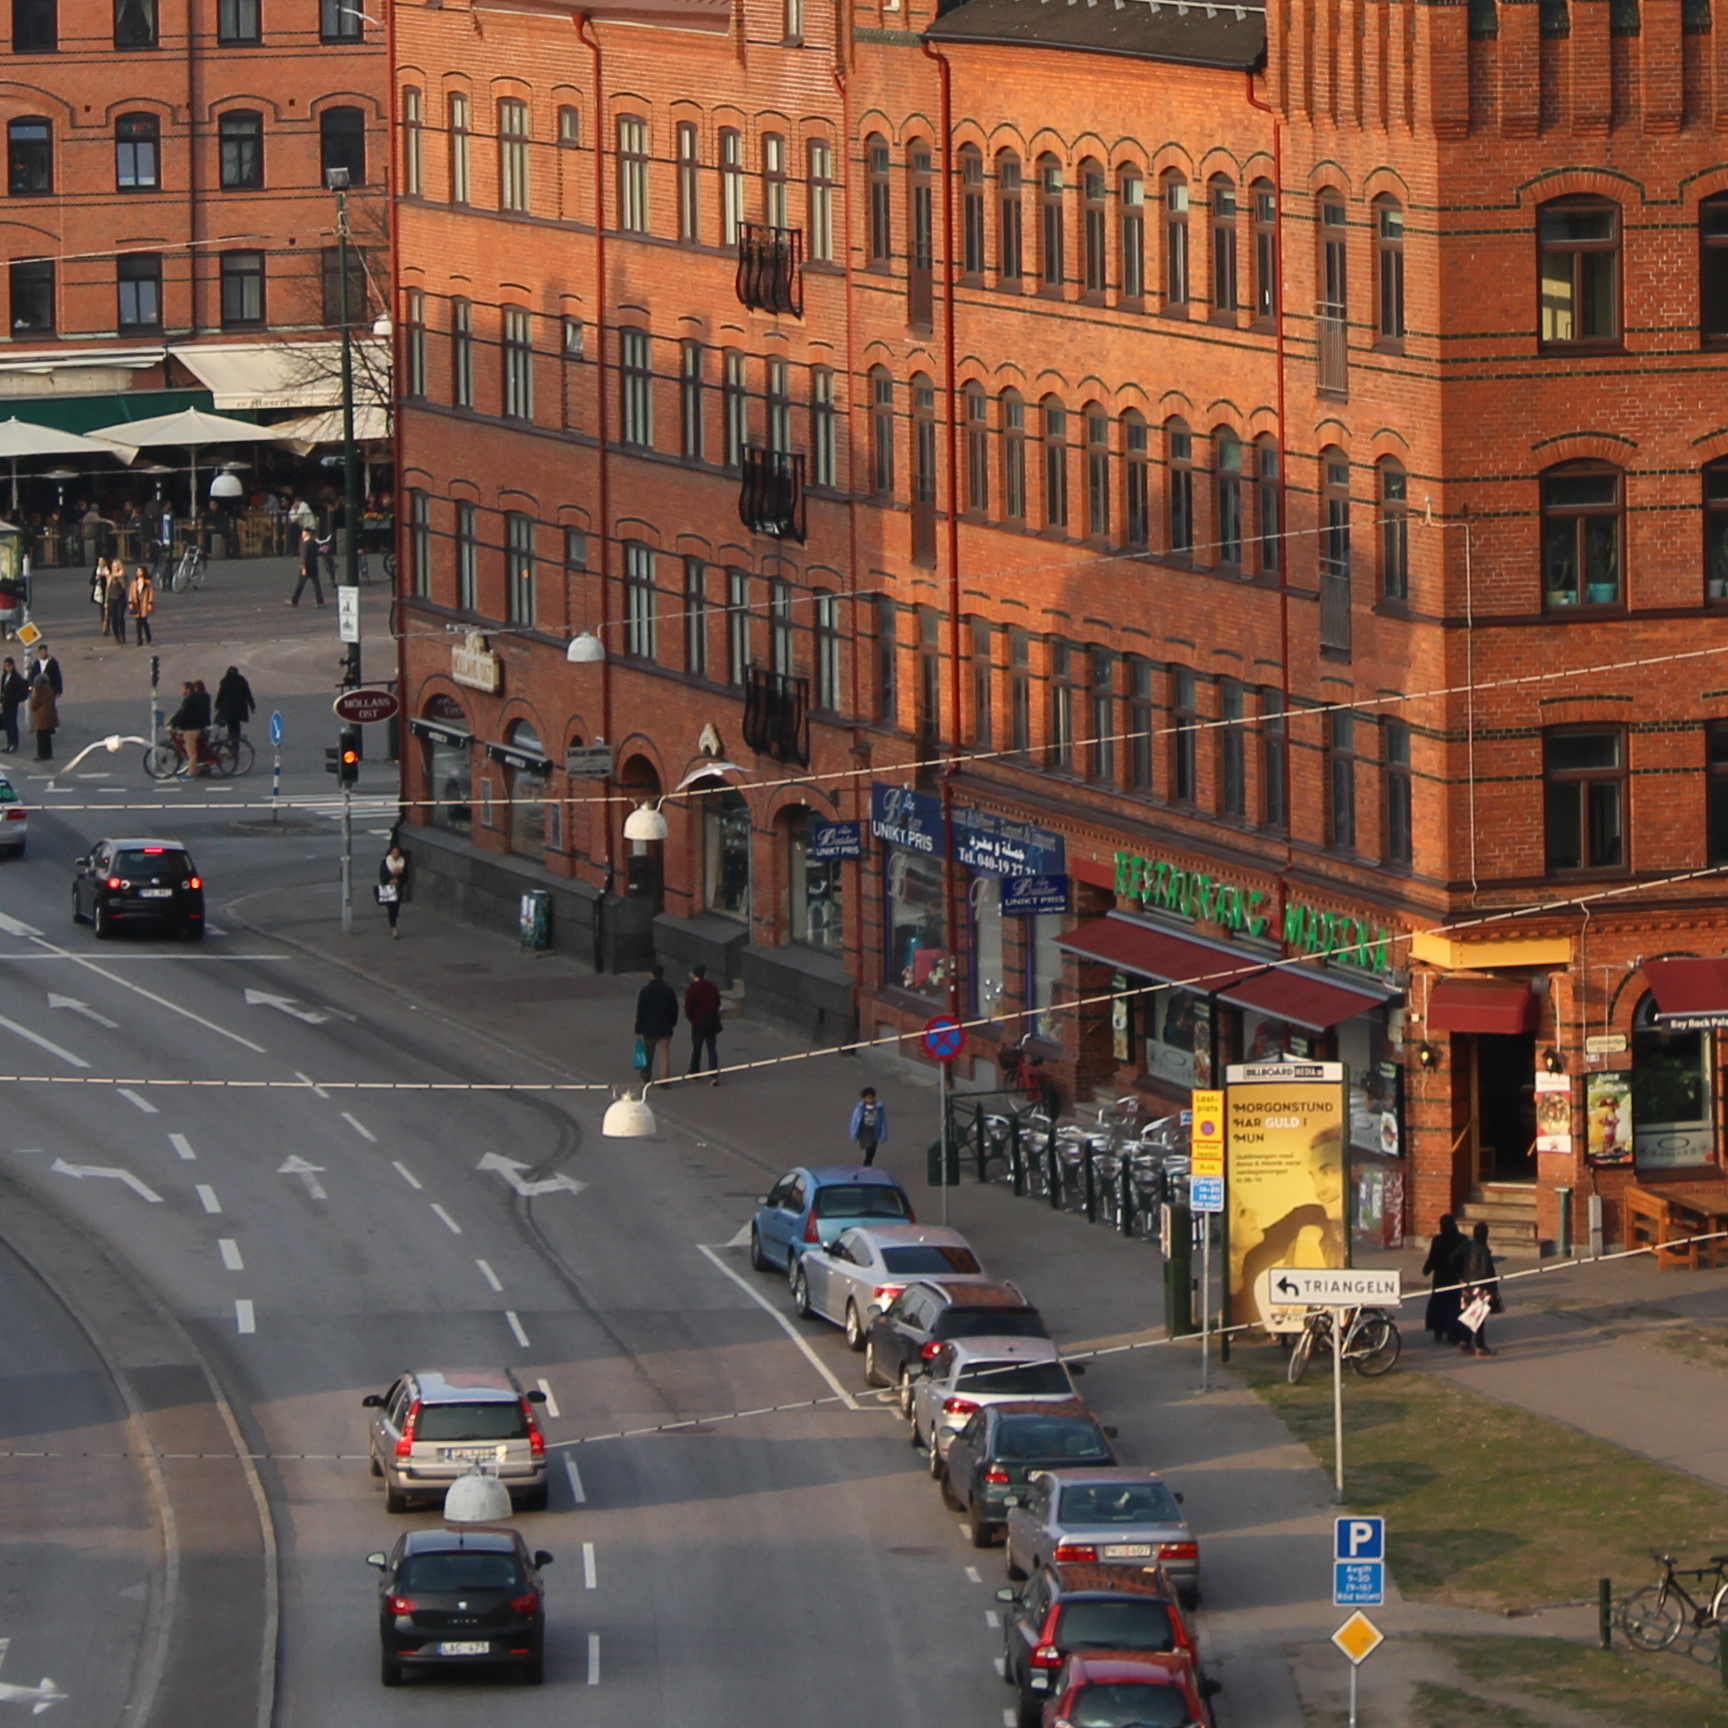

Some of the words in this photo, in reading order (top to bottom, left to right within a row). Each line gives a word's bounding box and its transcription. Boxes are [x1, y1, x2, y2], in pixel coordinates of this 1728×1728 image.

[359, 709, 379, 719] OST
[873, 819, 905, 845] UNIKT
[908, 829, 933, 853] PRIS
[816, 846, 840, 857] UNIKT
[841, 845, 860, 856] PRIS
[958, 847, 976, 865] Tel.
[1114, 851, 1265, 937] RESTAURANG
[1005, 897, 1038, 907] UNIKT
[1040, 895, 1066, 905] PRIS
[1233, 1102, 1334, 1114] MORGONSTUND
[1233, 1118, 1262, 1128] HAR
[1265, 1117, 1300, 1129] GULD
[1233, 1133, 1265, 1144] MUN
[1304, 1279, 1395, 1294] TRIANGELN
[1349, 1521, 1373, 1557] P
